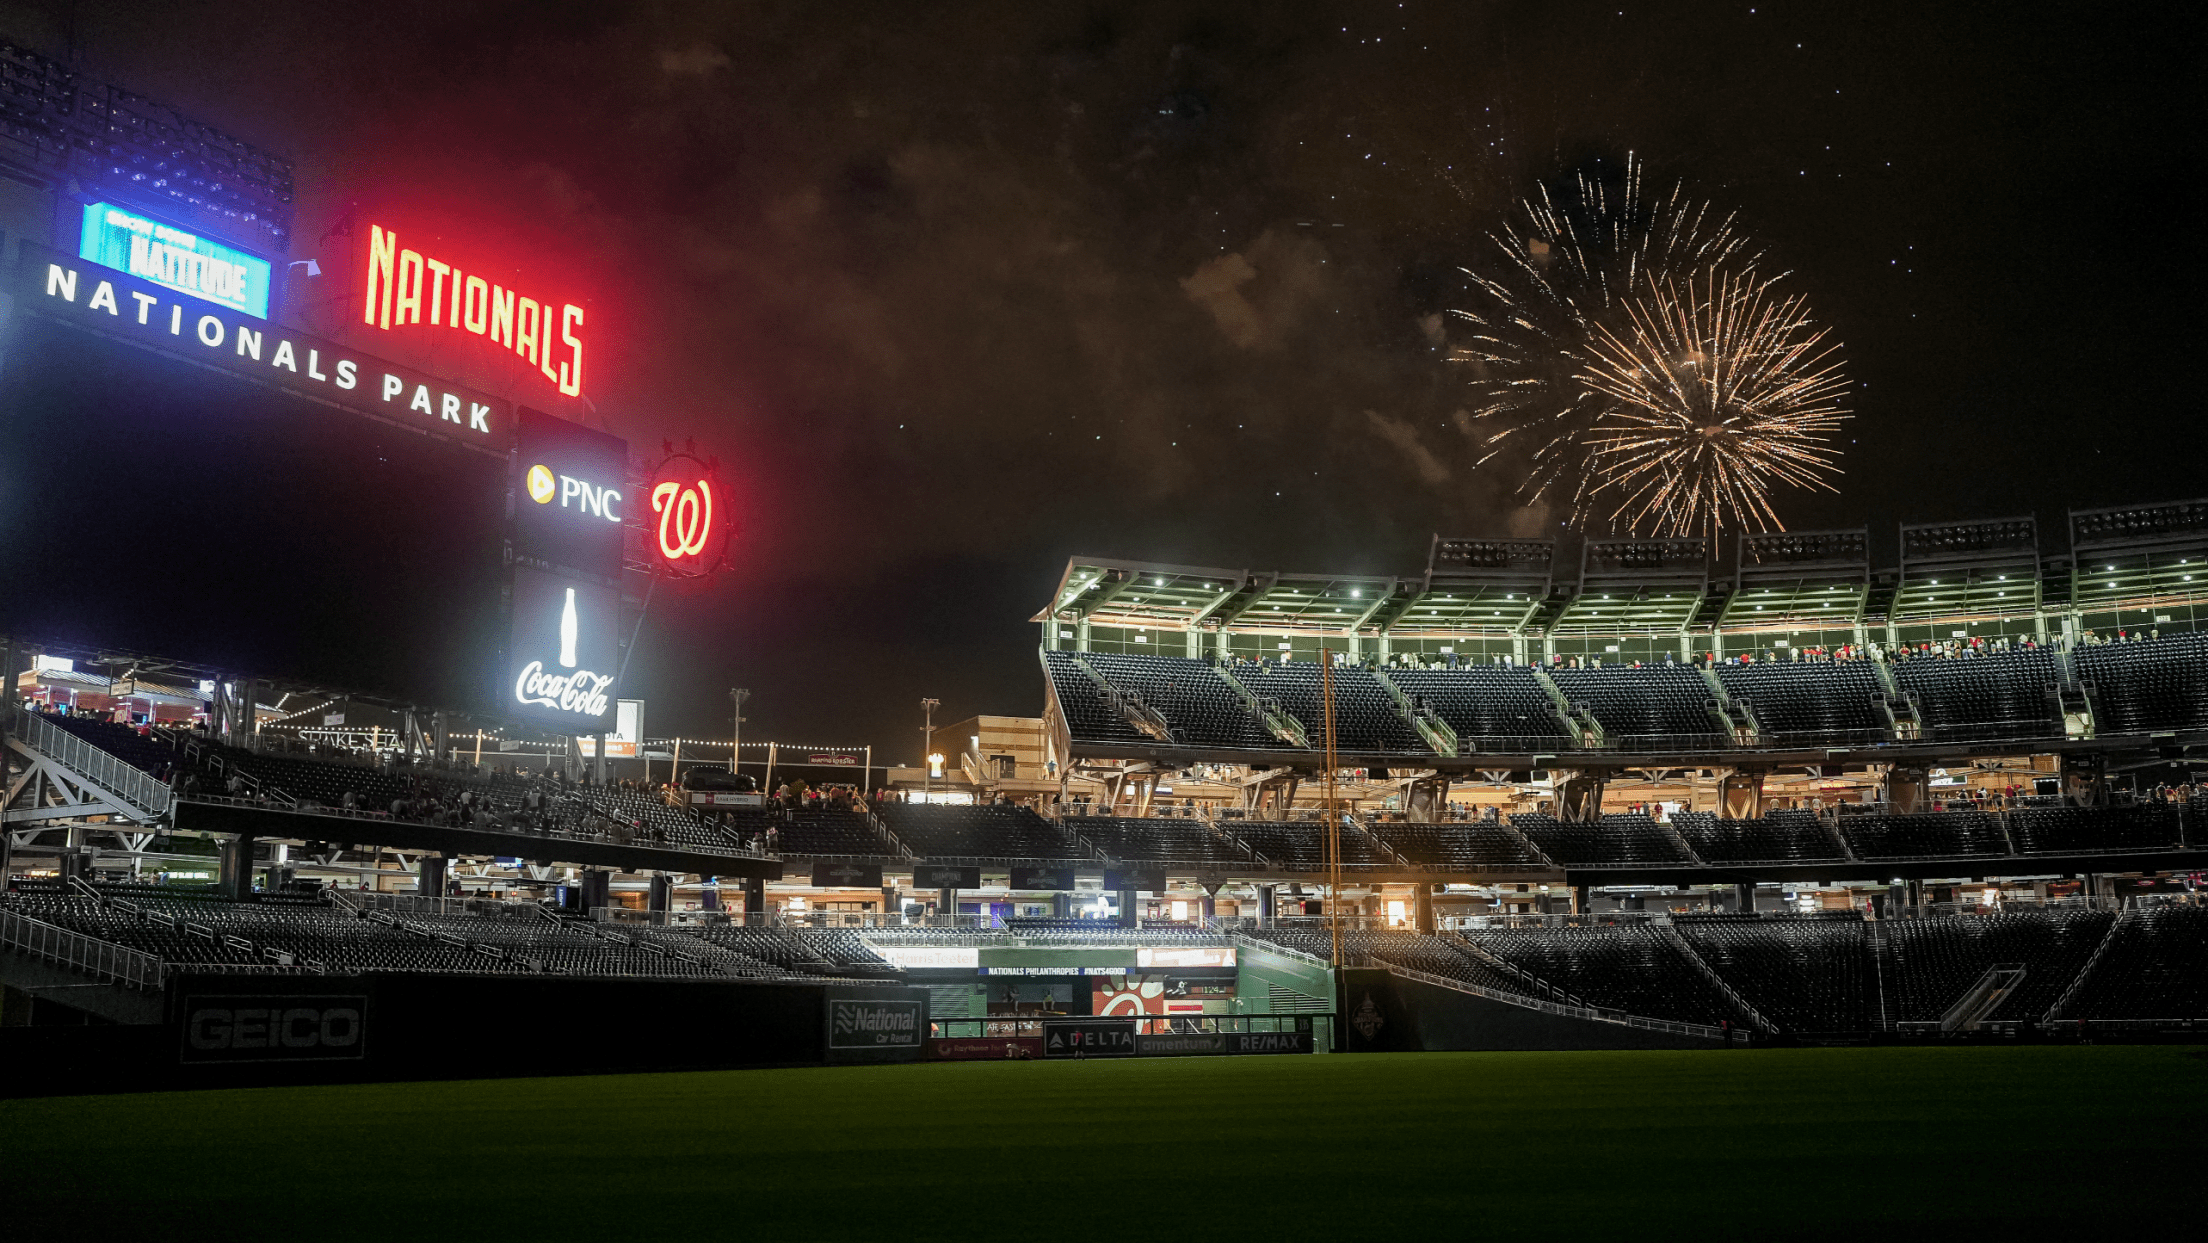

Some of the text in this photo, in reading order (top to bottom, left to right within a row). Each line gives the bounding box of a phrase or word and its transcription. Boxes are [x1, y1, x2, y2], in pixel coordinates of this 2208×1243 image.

[107, 211, 154, 235] SHOW
[130, 235, 248, 302] NATITUDE
[365, 223, 585, 397] NATIONALS
[46, 263, 492, 433] NATIONALS PARK
[561, 474, 622, 522] PNC
[652, 480, 712, 559] W
[515, 660, 614, 717] Coca-Cola
[364, 733, 406, 747] SHA
[896, 952, 975, 964] Harris Teeter
[988, 967, 1127, 976] NATIONALS PHILANTHROPIES #NATS4GOOD
[189, 1007, 360, 1051] GEICO
[854, 1004, 917, 1033] National
[876, 1033, 912, 1043] Car Rental
[1070, 1031, 1133, 1046] DELTA
[1142, 1037, 1211, 1050] amentum
[1240, 1035, 1300, 1050] RE/MAX
